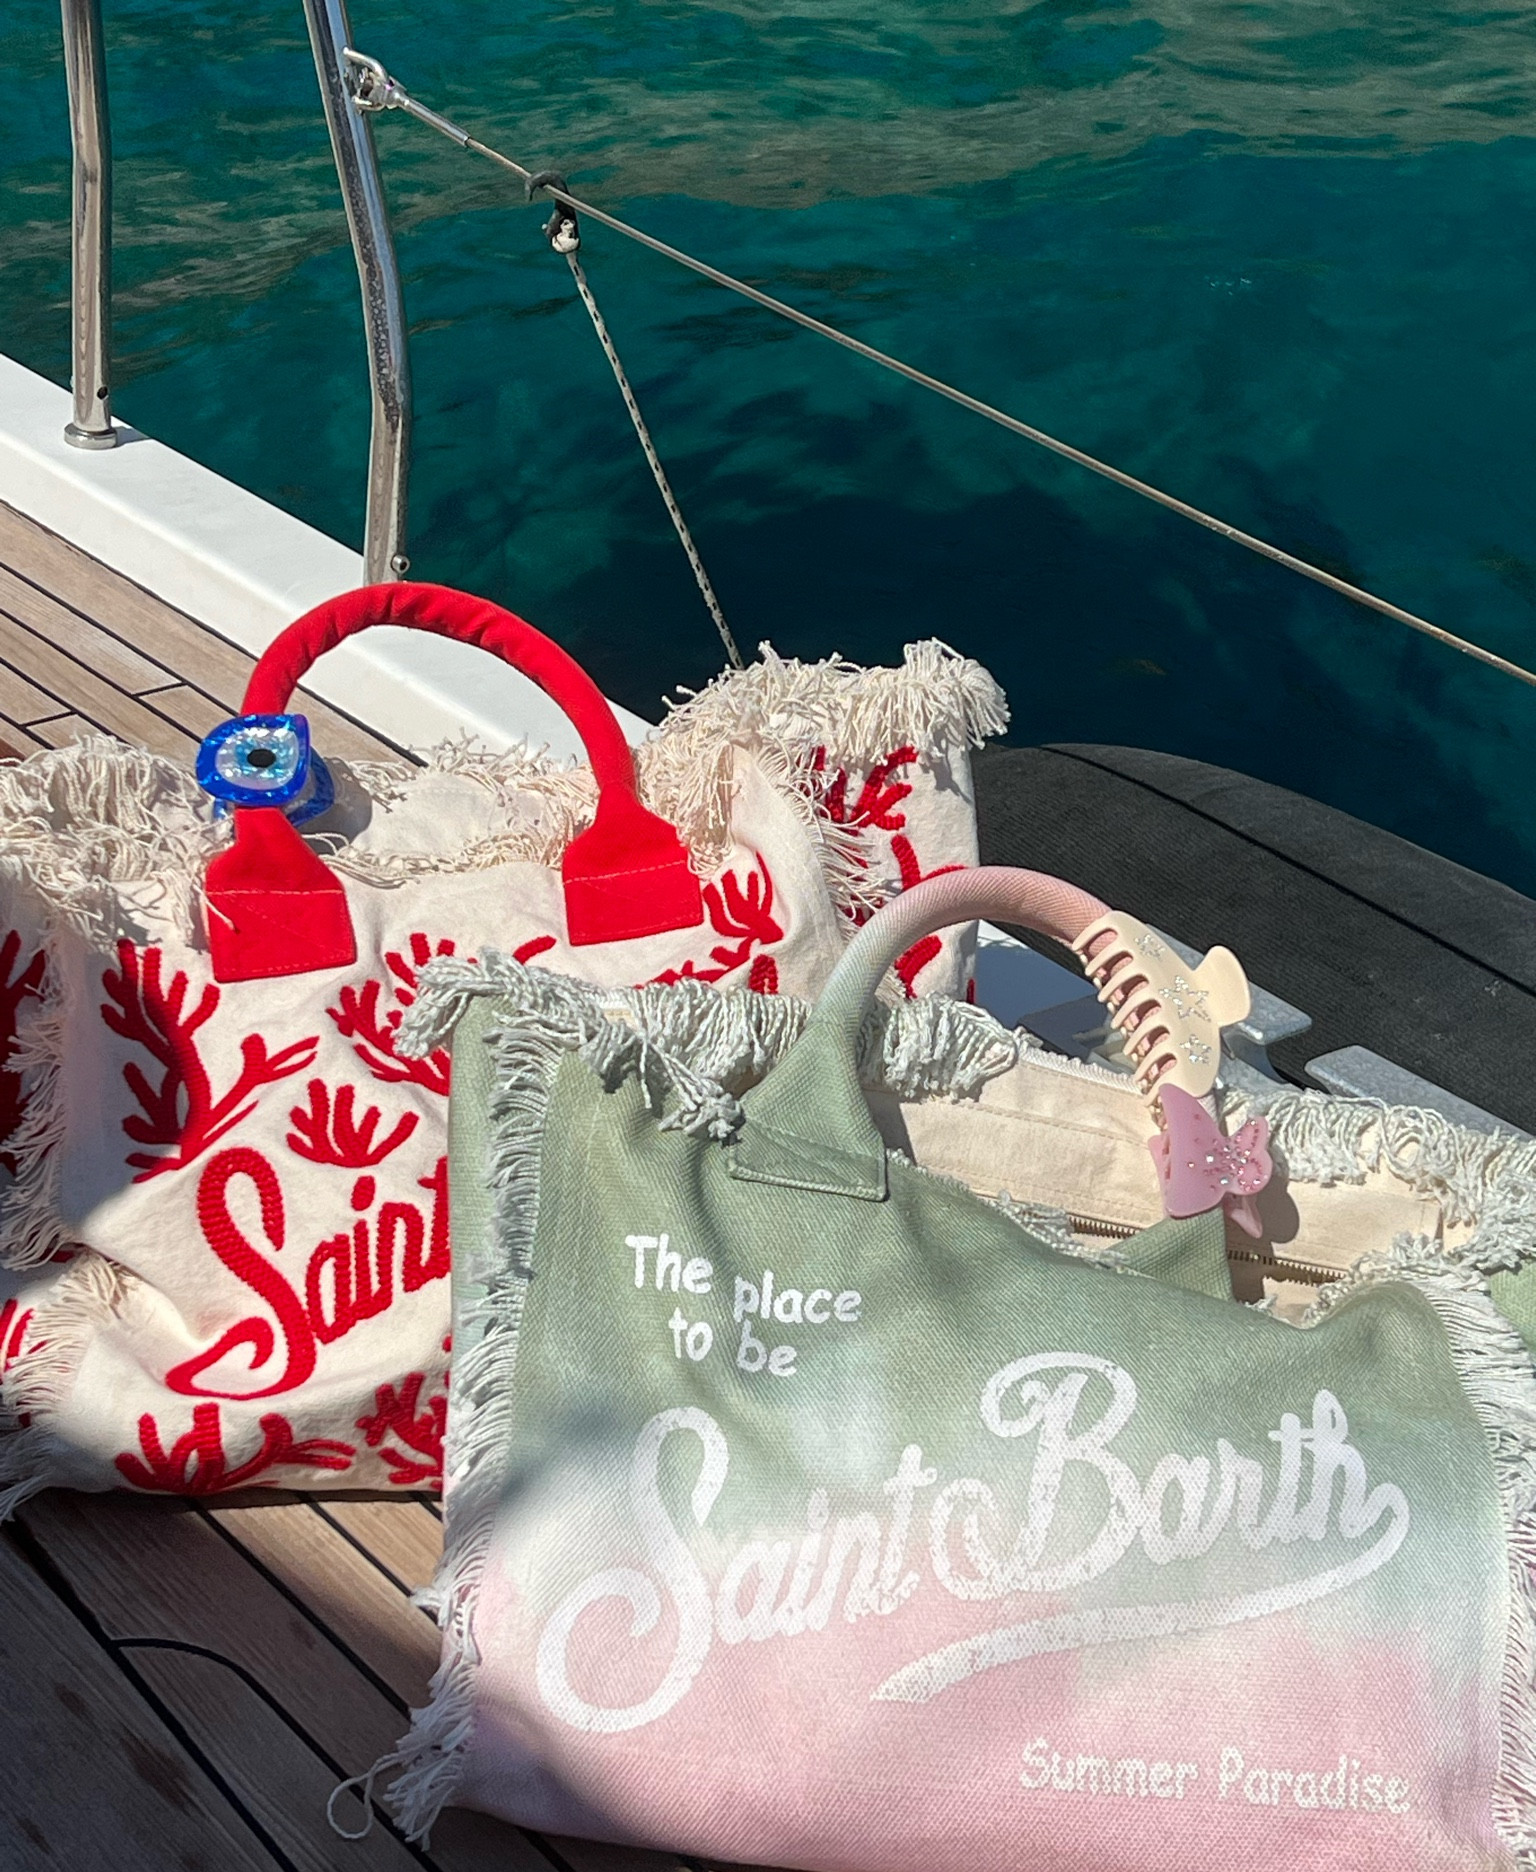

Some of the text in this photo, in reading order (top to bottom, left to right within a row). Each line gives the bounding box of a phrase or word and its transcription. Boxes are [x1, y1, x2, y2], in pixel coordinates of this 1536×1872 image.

[625, 1233, 862, 1324] The place
[668, 1306, 797, 1377] to be
[536, 1351, 1411, 1733] Saint Barth
[1019, 1737, 1411, 1814] Summer Paradise
